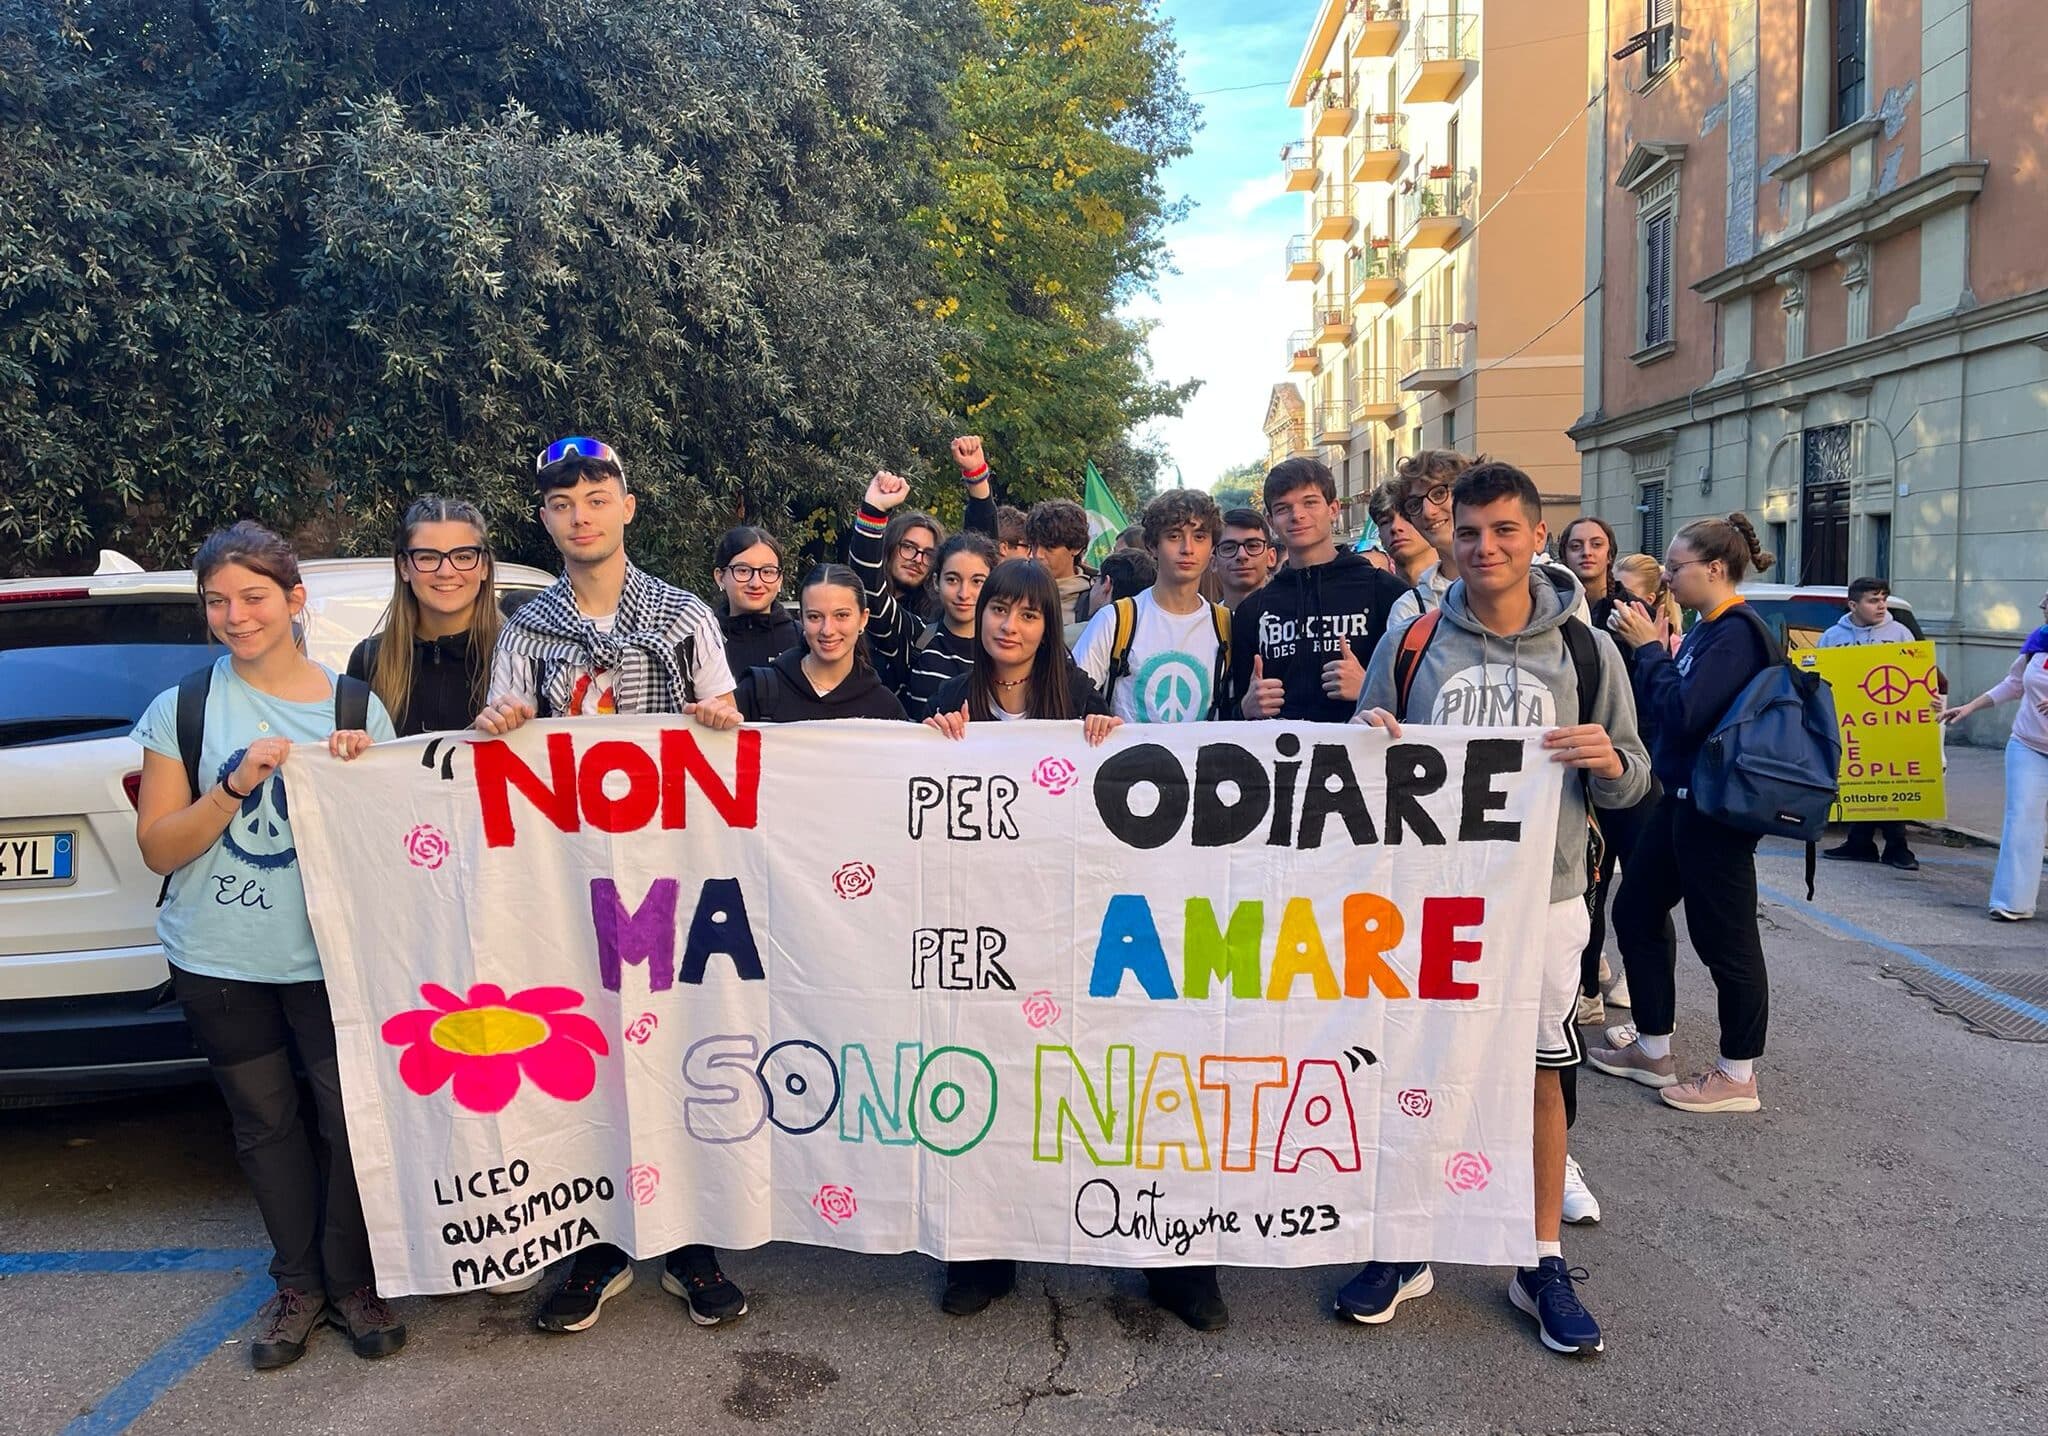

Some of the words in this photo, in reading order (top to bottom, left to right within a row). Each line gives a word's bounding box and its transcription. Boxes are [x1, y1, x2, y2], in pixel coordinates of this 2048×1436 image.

[1273, 643, 1296, 658] DES
[1841, 708, 1931, 728] AGINE
[1838, 761, 1920, 778] OPLE
[1843, 793, 1888, 803] ottobre
[1892, 791, 1921, 802] 2025
[908, 775, 1020, 841] PER
[211, 875, 273, 910] Eli
[590, 877, 766, 993] MA
[911, 927, 1017, 991] PER
[1088, 893, 1485, 1001] AMARE
[682, 1035, 998, 1157] SONO
[434, 1159, 530, 1206] LICEO
[442, 1176, 615, 1246] QUASIMODO
[1075, 1178, 1242, 1256] Antigone
[452, 1217, 601, 1288] MAGENTA
